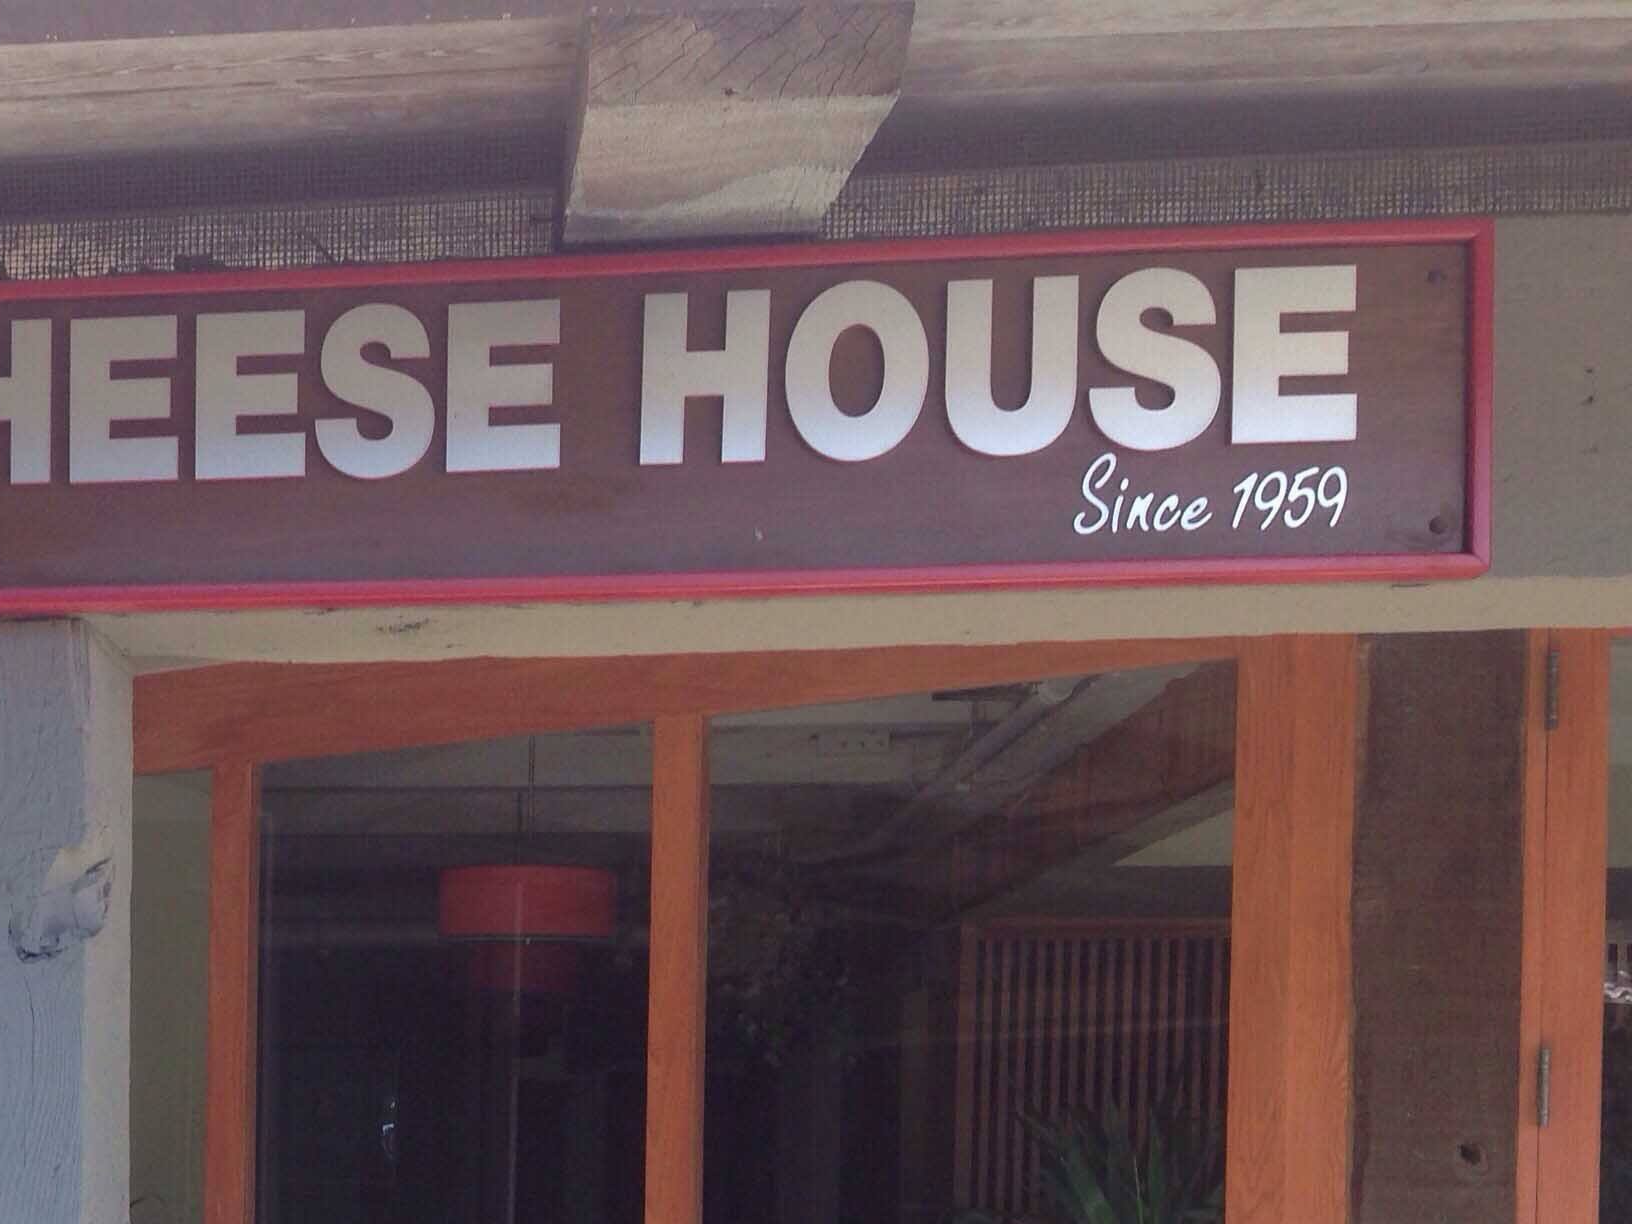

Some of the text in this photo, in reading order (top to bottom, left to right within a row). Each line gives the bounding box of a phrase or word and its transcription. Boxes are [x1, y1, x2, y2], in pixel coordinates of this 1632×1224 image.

[639, 264, 1358, 466] HOUSE
[1073, 452, 1348, 534] Since 1959
